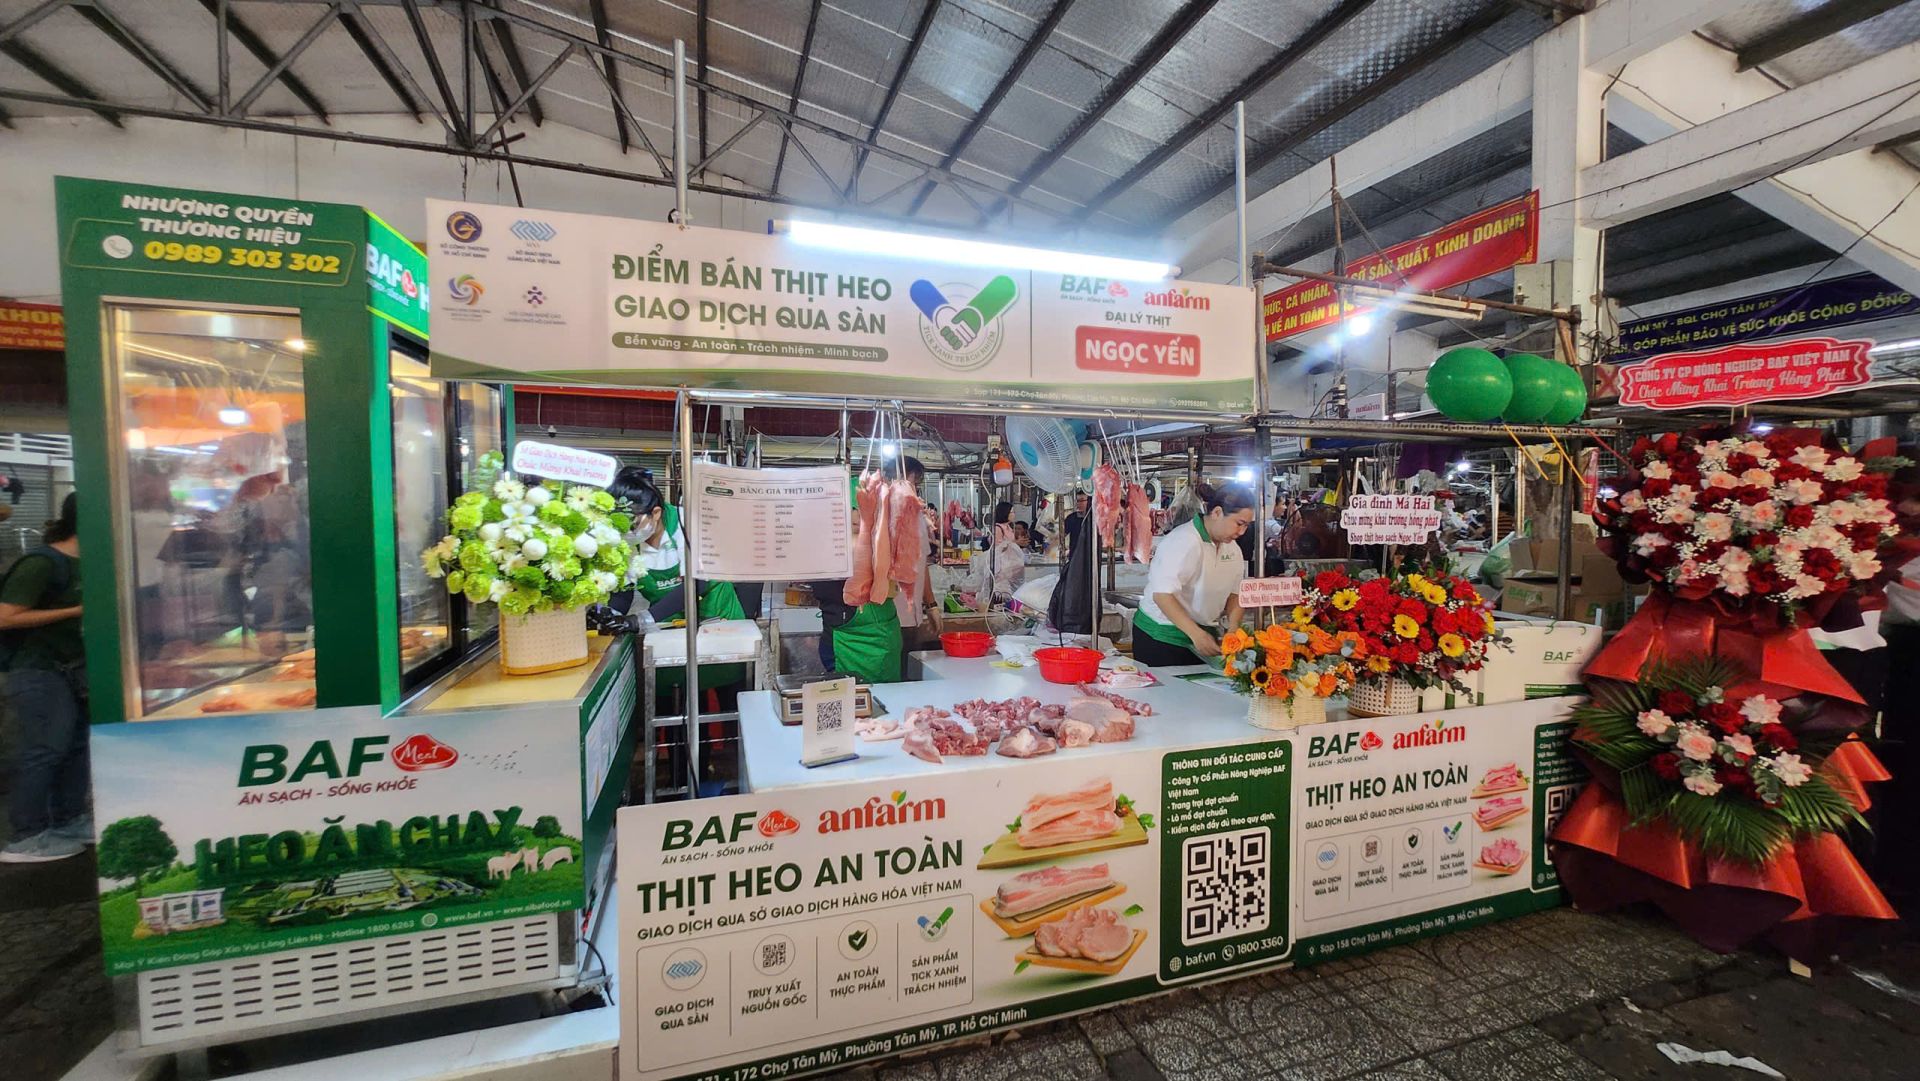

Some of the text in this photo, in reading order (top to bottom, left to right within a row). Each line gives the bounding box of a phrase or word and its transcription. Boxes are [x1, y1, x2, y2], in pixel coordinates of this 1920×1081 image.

[121, 194, 314, 226] NHƯỢNG QUYỀN
[139, 217, 301, 246] THƯƠNG HIỆU
[1435, 231, 1469, 258] KINH
[144, 241, 340, 274] 0989 303 302
[366, 242, 403, 287] BAF
[612, 244, 892, 302] ĐIỂM BÁN THỊT HEO
[1060, 274, 1210, 311] BAF anfarm
[1286, 292, 1298, 309] CÁ
[614, 294, 886, 335] GIAO DỊCH QUA SÀN
[1105, 311, 1172, 328] ĐẠI LÝ THỊT
[1283, 315, 1297, 330] AN
[1692, 326, 1718, 341] BẢO
[1722, 323, 1737, 338] VỆ
[1740, 315, 1766, 333] SỨC
[1810, 302, 1857, 321] CỘNG
[1861, 291, 1912, 312] ĐỒNG
[651, 336, 681, 350] vững
[692, 340, 707, 350] An
[710, 340, 737, 351] toàn
[747, 343, 778, 354] Trách
[782, 344, 815, 357] nhiệm
[824, 347, 849, 357] Minh
[852, 347, 879, 360] bạch
[1086, 336, 1195, 368] NGỌC YẾN
[1634, 367, 1660, 383] CÔNG
[1663, 367, 1676, 380] TY
[1678, 365, 1692, 378] CP
[1767, 356, 1789, 369] BAF
[1792, 351, 1819, 367] VIỆT
[1823, 350, 1850, 364] NAM
[1703, 378, 1728, 393] Khai
[1816, 366, 1847, 382] Phát
[740, 486, 764, 495] BẢNG
[1351, 496, 1367, 509] Gia
[1413, 497, 1430, 509] Hai
[1543, 651, 1574, 661] BAF
[1307, 723, 1465, 759] BAF anfarm
[237, 735, 438, 787] BAF Meat
[1172, 747, 1284, 770] THÔNG TIN ĐỐI TÁC CUNG CẤP
[238, 775, 419, 806] ĂN SẠCH SỐNG KHỎE
[1306, 762, 1468, 810] THỊT HEO AN TOÀN
[1171, 801, 1191, 810] Trang
[661, 810, 757, 851] BAF
[818, 796, 946, 834] anfarm
[194, 805, 523, 876] HEO ĂN CHAY
[637, 835, 962, 916] THỊT HEO AN TOÀN
[332, 927, 366, 939] Hotline
[367, 923, 390, 934] 1800
[392, 920, 415, 931] 6263
[444, 909, 494, 924] www.baf.vn
[637, 879, 962, 940] GIAO DỊCH QUA SỞ GIAO DỊCH HÀNG HÓA VIỆT NAM
[1185, 936, 1284, 966] baf.vn 1800 3360
[747, 978, 802, 1000] TRUY XUẤT
[836, 965, 880, 983] AN TOÀN
[782, 992, 808, 1006] GỐC
[829, 984, 856, 998] THỰC
[734, 1008, 1027, 1081] 172 Chợ Tân Mỹ, Phường Tân Mỹ, TP. Hồ Chí Minh
